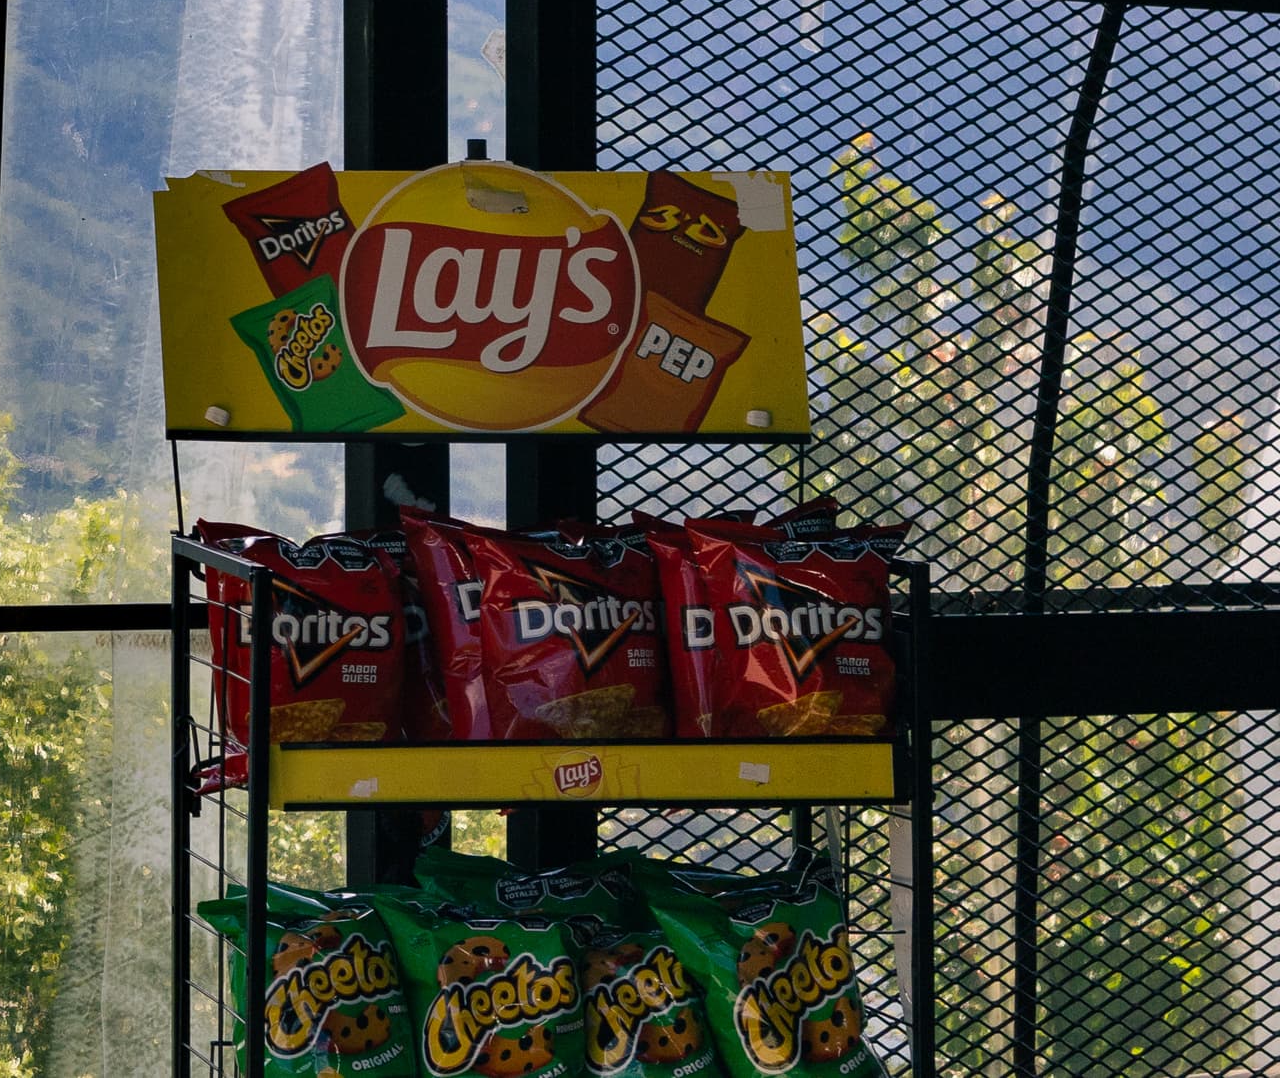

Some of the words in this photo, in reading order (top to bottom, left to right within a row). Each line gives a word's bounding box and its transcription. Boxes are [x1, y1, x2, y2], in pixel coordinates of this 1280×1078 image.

[258, 210, 346, 261] Doritos
[365, 226, 619, 374] Lay's
[278, 304, 333, 389] Cheetos
[636, 322, 716, 383] PEP
[517, 594, 656, 640] Doritos
[728, 601, 884, 646] Doritos
[341, 664, 378, 674] SABOR
[342, 674, 377, 684] QUESO
[835, 656, 870, 667] SABOR
[839, 666, 871, 676] QUESO
[558, 759, 601, 790] Lay's
[426, 956, 578, 1071] Cheetos
[351, 1043, 404, 1072] ORIGINAL
